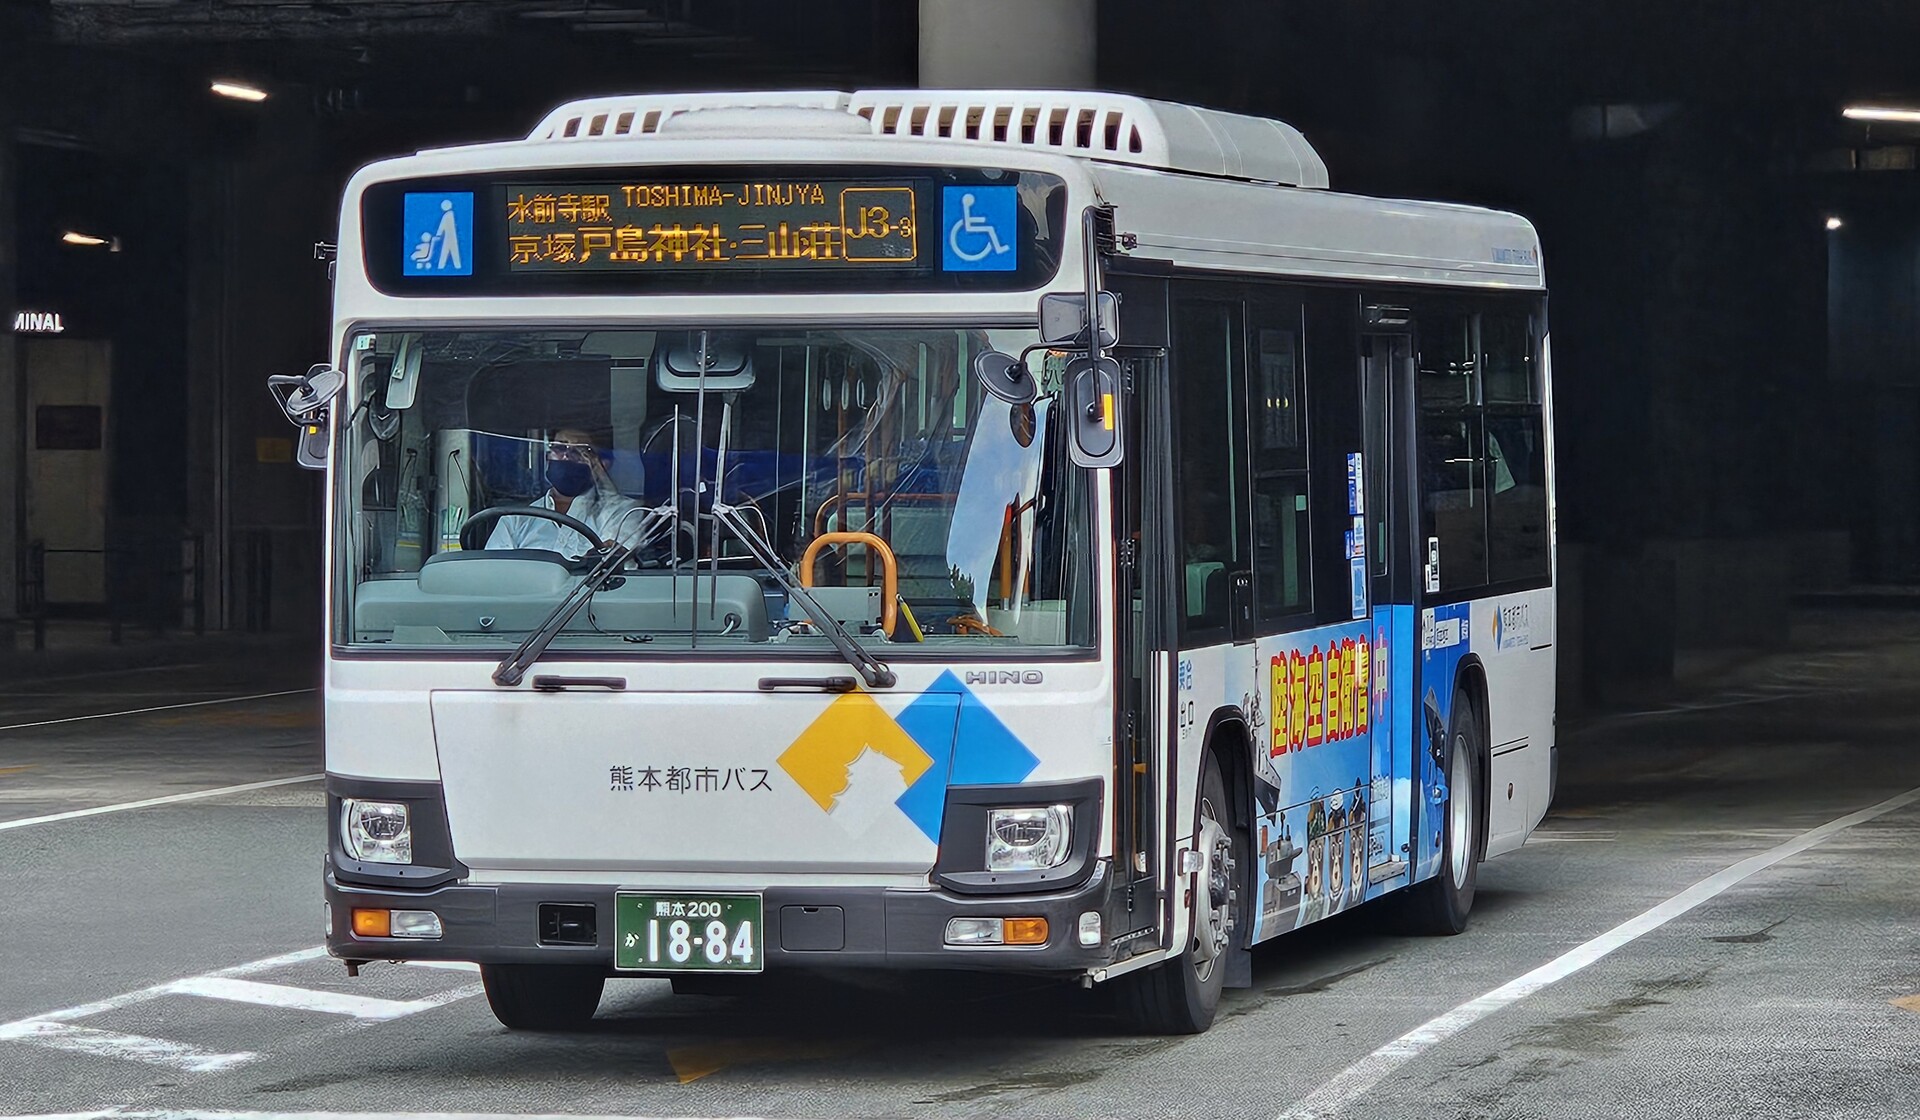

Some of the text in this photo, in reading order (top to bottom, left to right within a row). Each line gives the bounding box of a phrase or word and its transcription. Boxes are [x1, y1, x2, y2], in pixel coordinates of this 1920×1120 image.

[508, 193, 613, 224] 水前寺駅
[622, 184, 825, 208] TOSHIMA-JINJYA
[847, 206, 912, 239] J3-3
[966, 670, 1044, 685] HINO
[609, 765, 773, 795] 熊本都市バス
[624, 919, 754, 964] か 18-84
